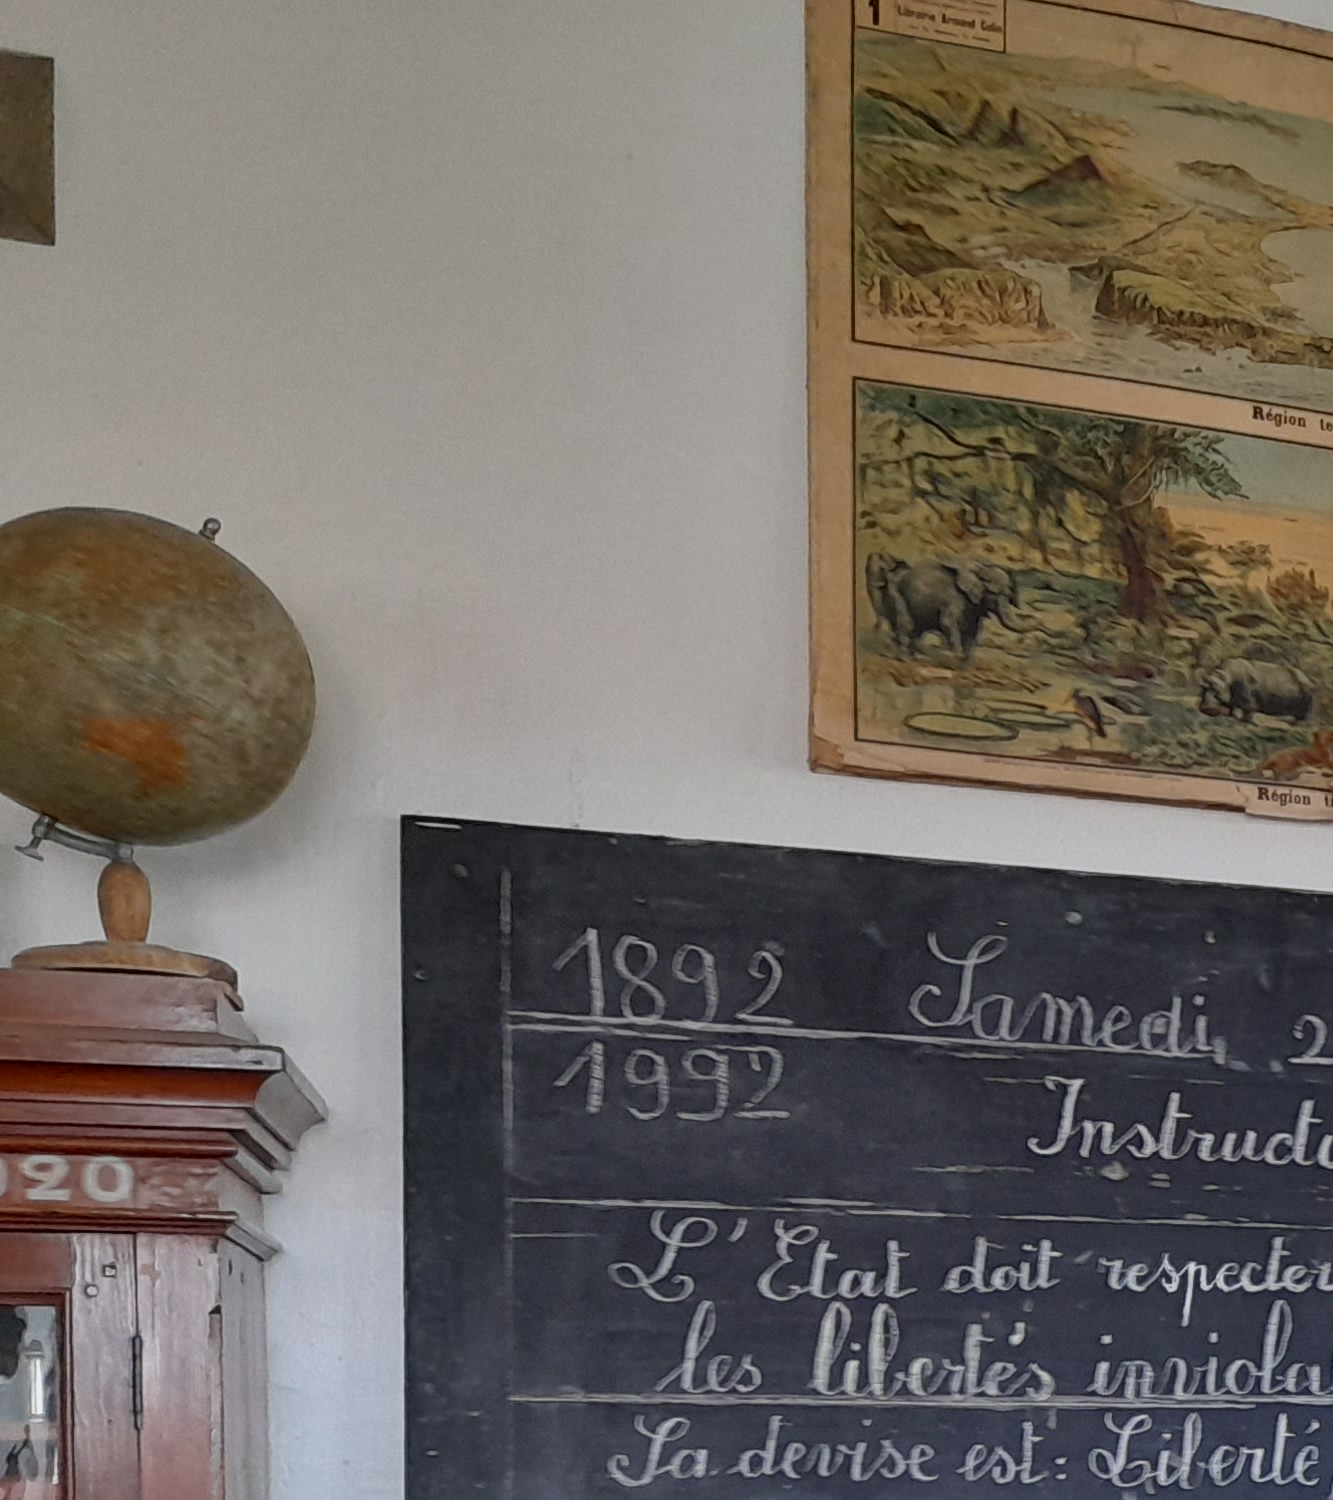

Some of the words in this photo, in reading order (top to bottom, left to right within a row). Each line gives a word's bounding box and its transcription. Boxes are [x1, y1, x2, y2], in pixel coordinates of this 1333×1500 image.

[1252, 406, 1306, 428] Région
[1257, 786, 1312, 806] Région
[551, 926, 793, 1028] 1892
[551, 1043, 791, 1121] 1992
[0, 1153, 137, 1202] 20
[654, 1300, 763, 1394] les
[806, 1300, 1057, 1400] libertés
[728, 1414, 940, 1480] devise
